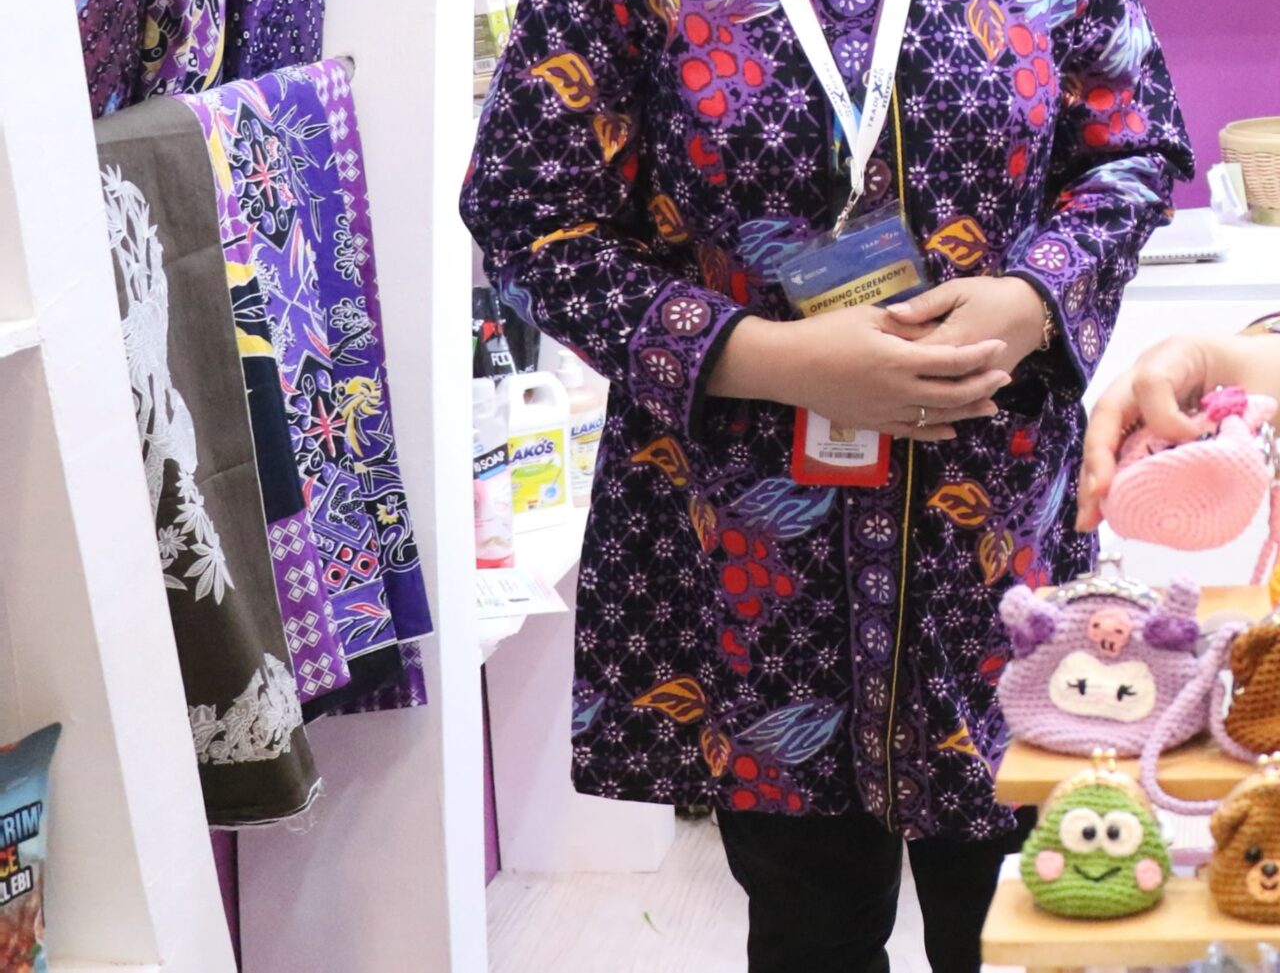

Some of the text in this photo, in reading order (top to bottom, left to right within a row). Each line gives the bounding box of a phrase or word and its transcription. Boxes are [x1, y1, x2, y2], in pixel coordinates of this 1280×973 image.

[810, 290, 853, 313] OPENING
[854, 266, 908, 294] CEREMONY
[857, 288, 882, 304] 2026
[480, 450, 505, 470] SOAP
[509, 439, 554, 464] AKO'S
[11, 870, 31, 895] EBI
